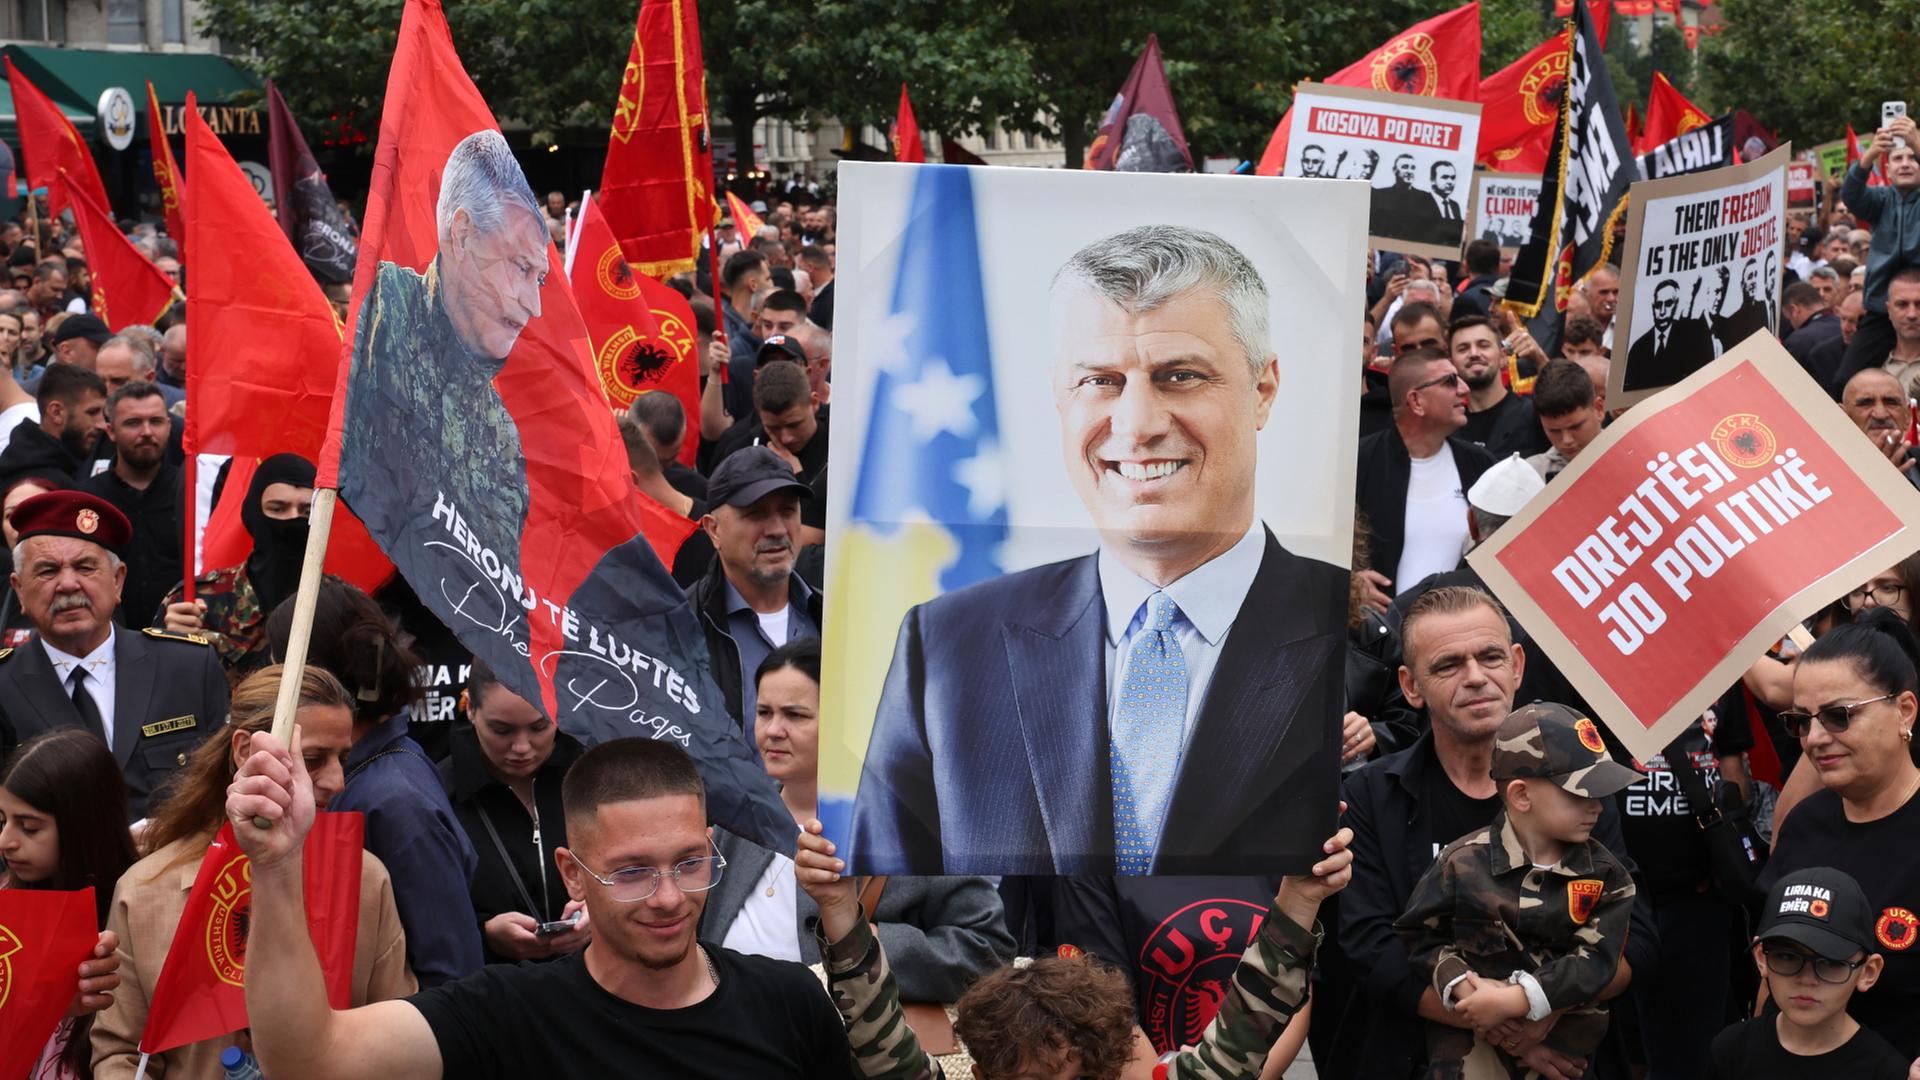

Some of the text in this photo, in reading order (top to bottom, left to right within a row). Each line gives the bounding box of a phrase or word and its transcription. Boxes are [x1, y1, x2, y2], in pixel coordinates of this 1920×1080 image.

[1315, 110, 1453, 147] KOSOVA PO PRET
[1675, 182, 1772, 236] THEIR FREEDOM
[1646, 245, 1665, 277] IS
[1669, 240, 1699, 273] THE
[1701, 231, 1739, 267] ONLY
[1551, 441, 1738, 609] DREJTËSI
[432, 490, 537, 610] HERONJ
[542, 598, 580, 641] TË
[1598, 447, 1833, 656] JO POLITIKË
[423, 541, 532, 656] Dhe
[409, 690, 456, 722] MËR
[1779, 897, 1810, 913] EMËR
[1784, 885, 1831, 901] LIRIA KA
